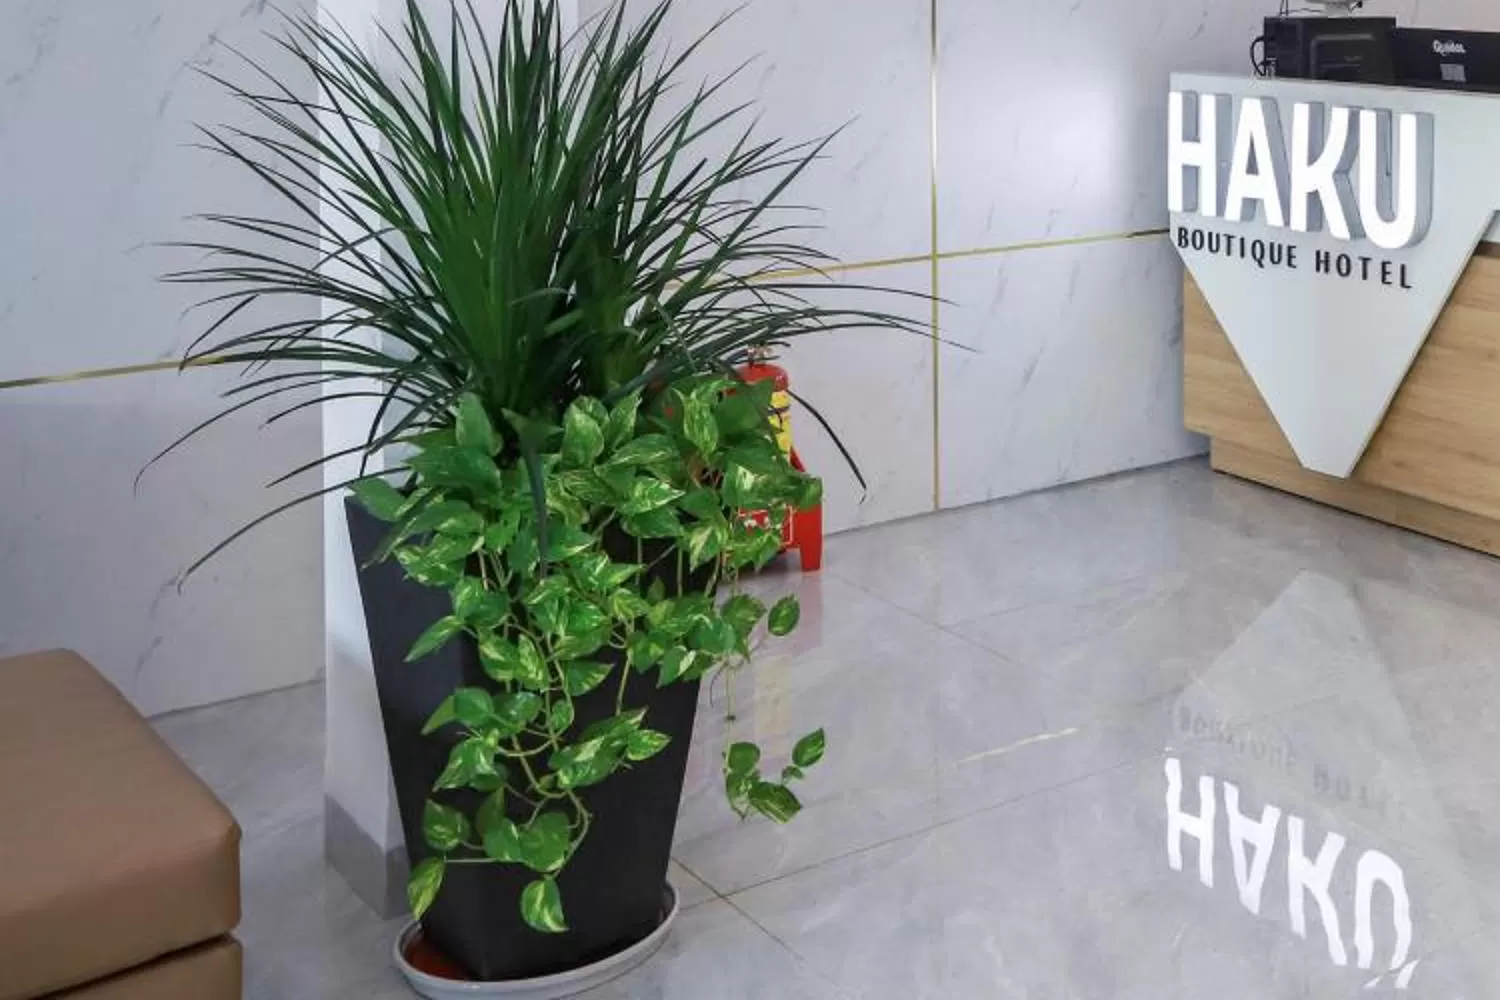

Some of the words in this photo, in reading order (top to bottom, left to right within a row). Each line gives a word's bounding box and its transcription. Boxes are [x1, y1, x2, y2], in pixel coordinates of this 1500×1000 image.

[1168, 90, 1433, 249] HAKU
[1177, 226, 1298, 269] BOUTIQUE
[1314, 249, 1412, 289] HOTEL
